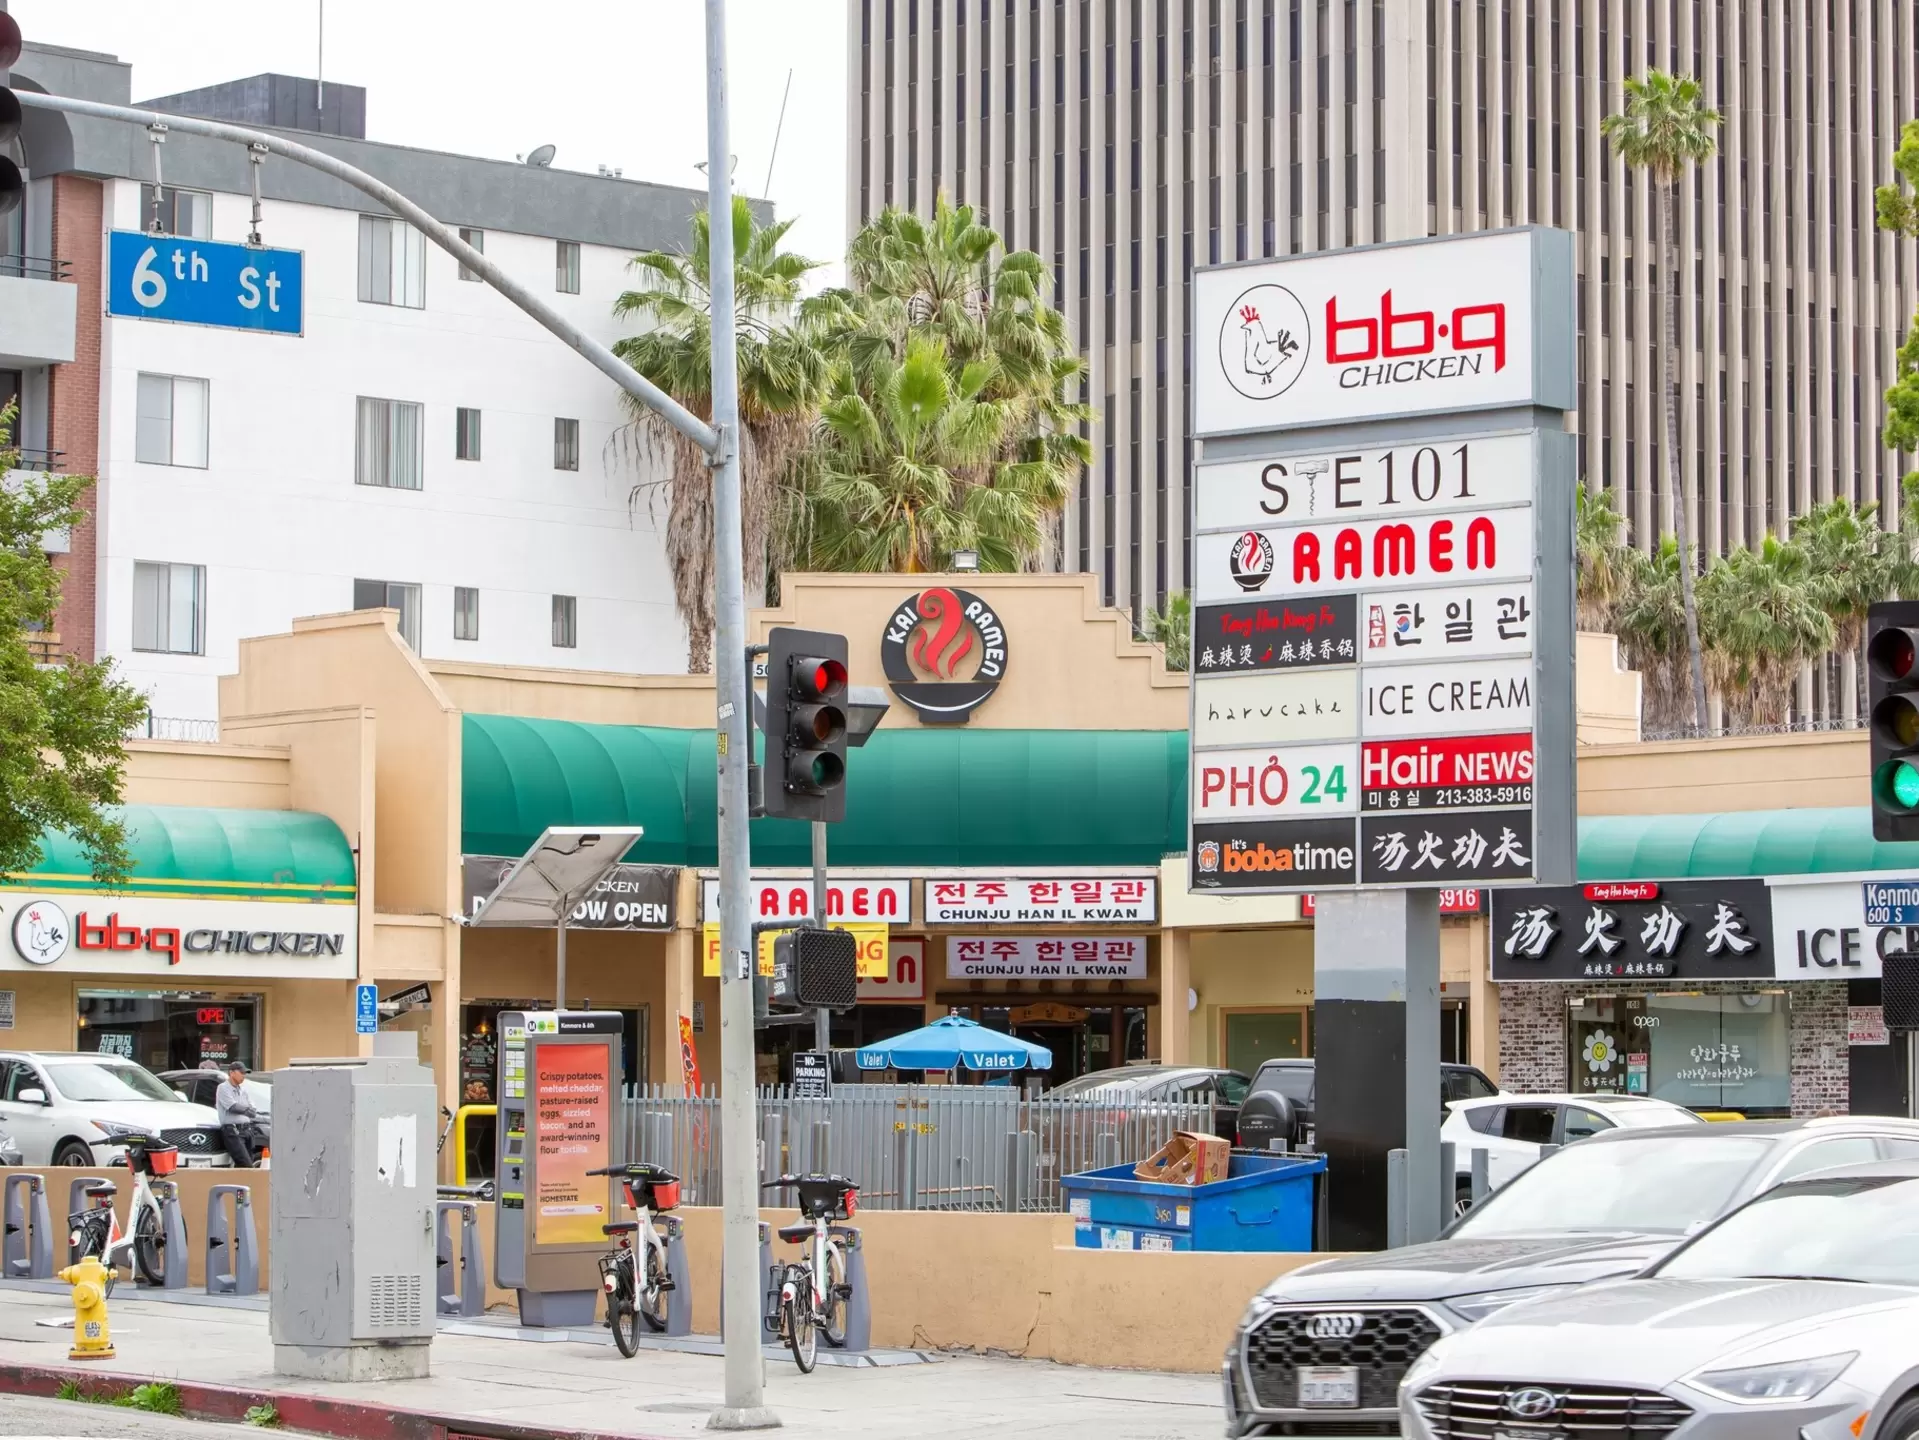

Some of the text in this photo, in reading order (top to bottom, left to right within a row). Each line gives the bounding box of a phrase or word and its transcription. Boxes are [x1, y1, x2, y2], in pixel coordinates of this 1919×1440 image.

[132, 246, 281, 313] 6th St
[1339, 353, 1483, 389] CHICKEN
[1293, 517, 1496, 584] RAMEN
[887, 601, 1004, 677] KAI RAMEN
[1199, 638, 1355, 668] 麻辣烫 麻辣香锅
[1368, 677, 1531, 716] ICE CREAM
[1208, 698, 1342, 722] harucake
[1363, 745, 1533, 787] Hair NEWS
[1299, 765, 1348, 804] 24
[1436, 786, 1532, 805] 213-383-5916
[1231, 838, 1247, 850] it's
[934, 881, 1147, 905] 전주 한일관
[760, 887, 897, 916] RAMEN
[572, 901, 668, 923] OW OPEN
[939, 908, 1138, 920] CHUNJU HAN IL KWAN
[1868, 907, 1903, 923] 600 S
[184, 929, 345, 956] CHICKEN
[1797, 928, 1862, 968] ICE
[957, 940, 1137, 962] 전주 한일관
[965, 965, 1128, 975] CHUNJU HAN IL KWAN
[198, 1009, 234, 1024] OPEN
[1633, 1015, 1660, 1029] open
[804, 1056, 815, 1066] NO
[863, 1052, 883, 1067] Valet
[974, 1053, 1015, 1068] Valet
[540, 1072, 604, 1081] Crispy potatoes,
[796, 1067, 825, 1077] PARKING
[540, 1083, 604, 1093] melted cheddar,
[540, 1096, 599, 1106] pasture-raised
[563, 1108, 591, 1117] sizzled
[568, 1120, 583, 1129] and
[585, 1121, 595, 1129] an
[540, 1131, 600, 1143] award-winning
[540, 1145, 559, 1154] flour
[540, 1194, 579, 1203] HOMESTATE
